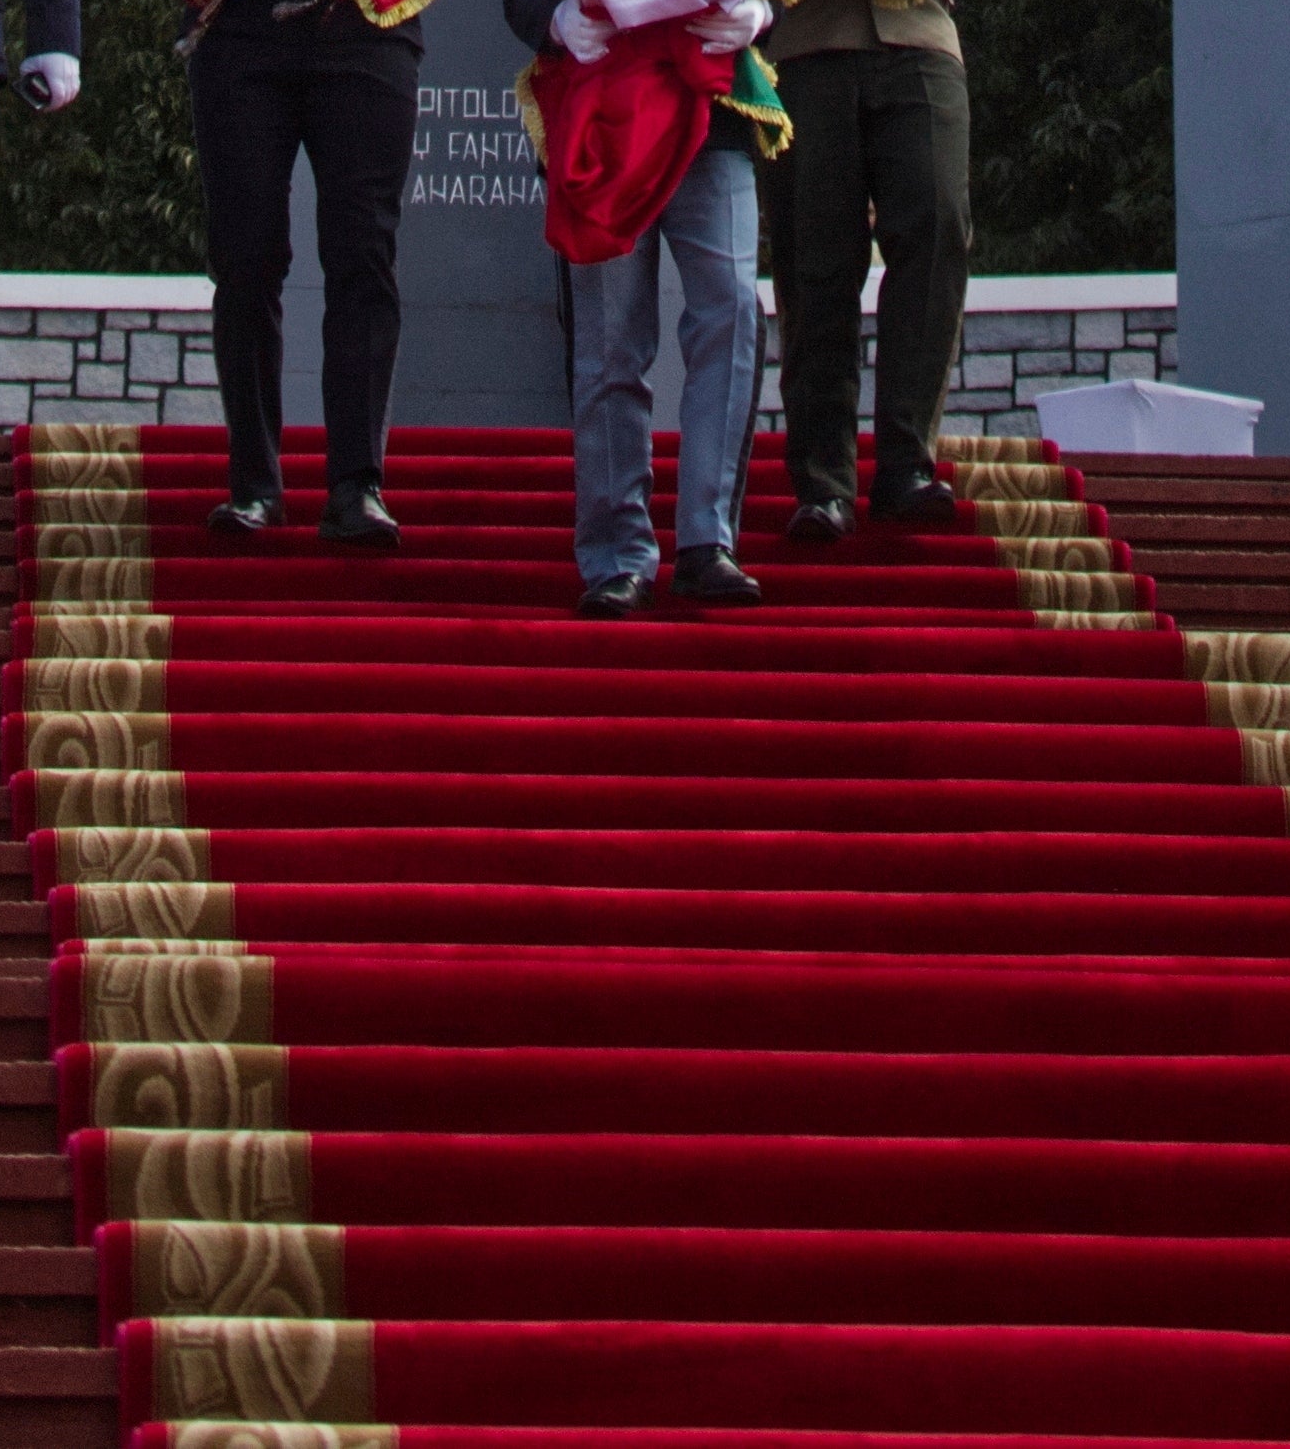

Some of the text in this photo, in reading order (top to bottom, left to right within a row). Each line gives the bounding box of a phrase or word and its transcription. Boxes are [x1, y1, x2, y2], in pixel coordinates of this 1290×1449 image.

[417, 87, 526, 128] PITOLO
[413, 131, 538, 169] Y FANTA
